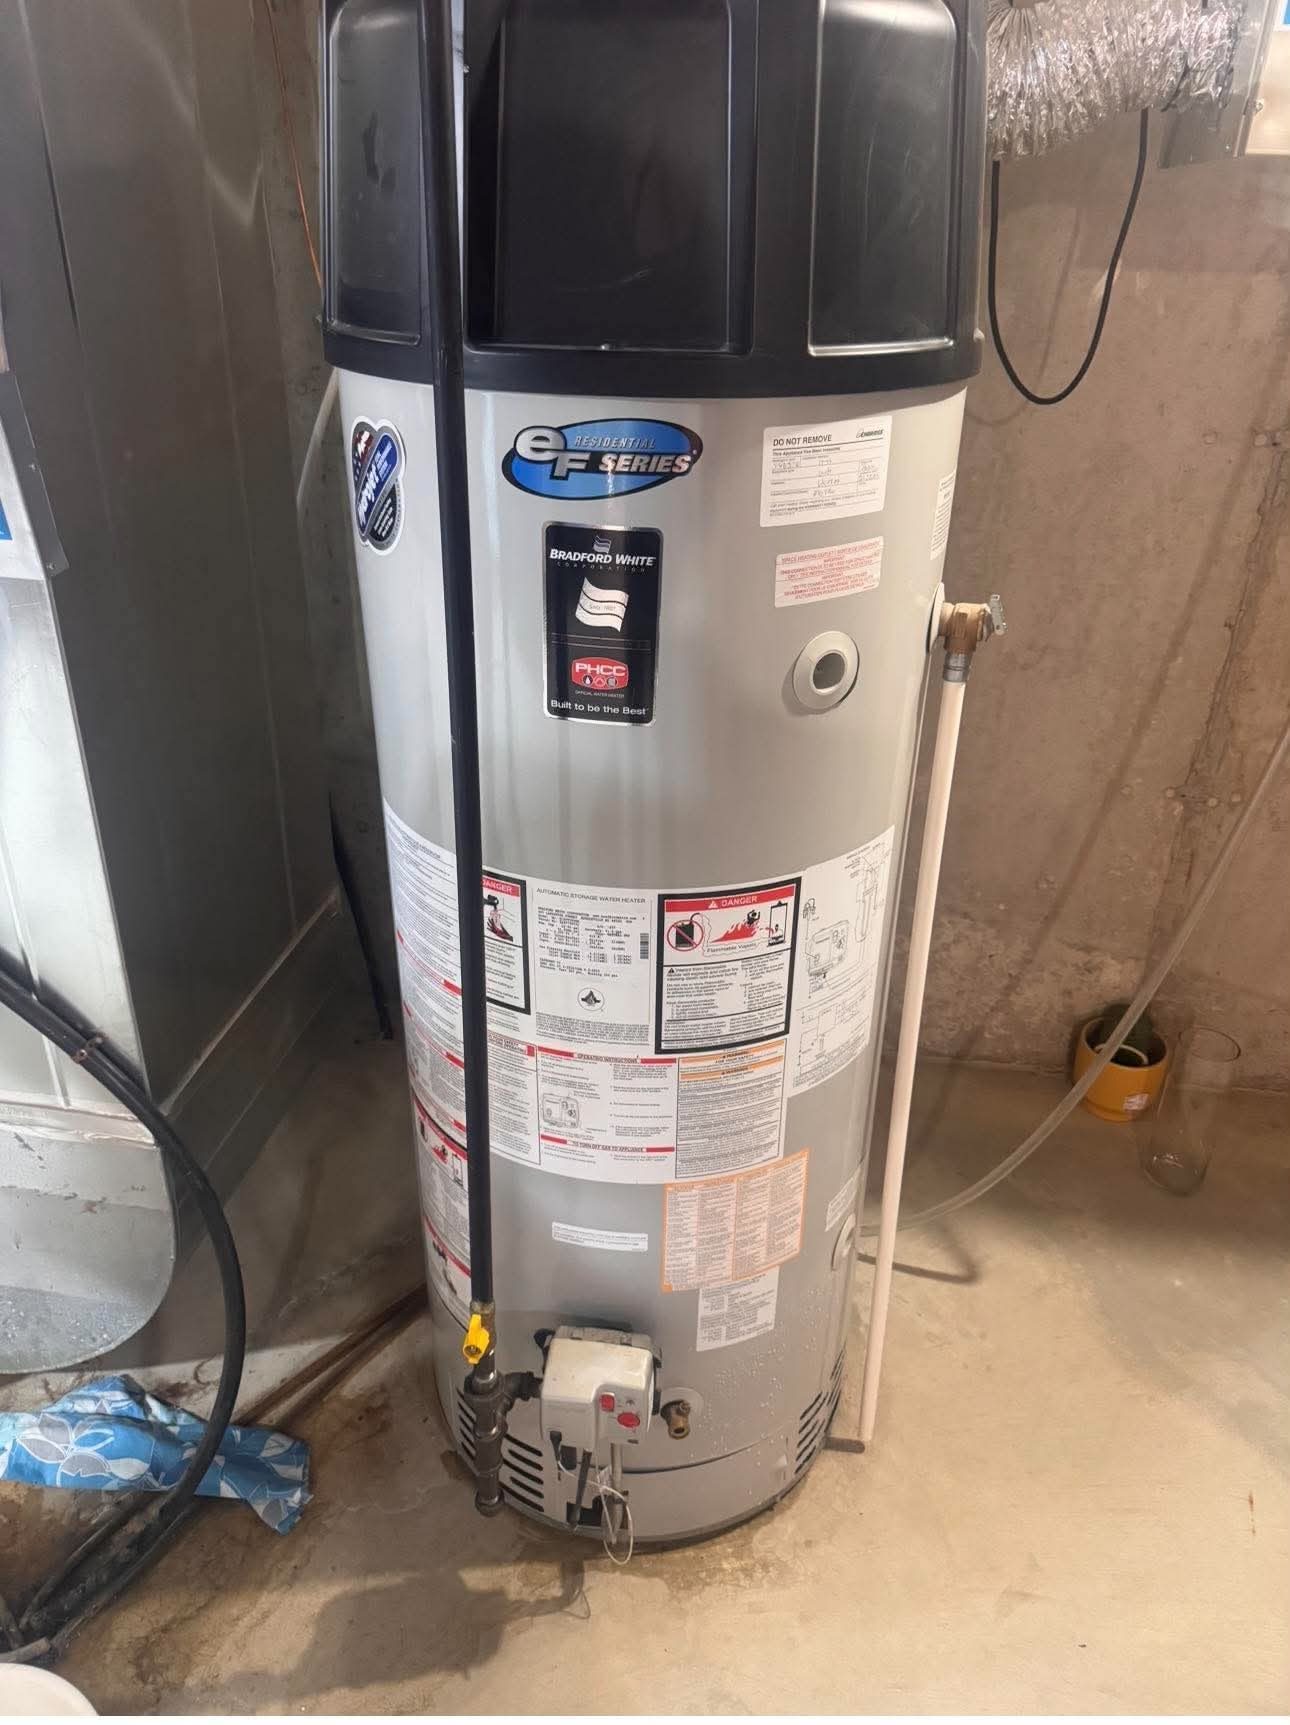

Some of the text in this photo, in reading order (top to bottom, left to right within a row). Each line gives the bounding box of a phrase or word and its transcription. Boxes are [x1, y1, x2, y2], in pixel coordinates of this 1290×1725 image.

[575, 435, 656, 449] RESIDENTIAL
[773, 434, 832, 447] DO NOT REMOVE
[598, 453, 692, 474] SERIES
[549, 549, 656, 567] BRADFORD WHITE
[575, 662, 627, 677] PHCC
[550, 699, 646, 716] Built to be the Best
[536, 887, 570, 898] AUTOMATIC
[570, 892, 598, 901] STORAGE
[599, 895, 621, 903] WATER
[721, 895, 758, 908] DANGER
